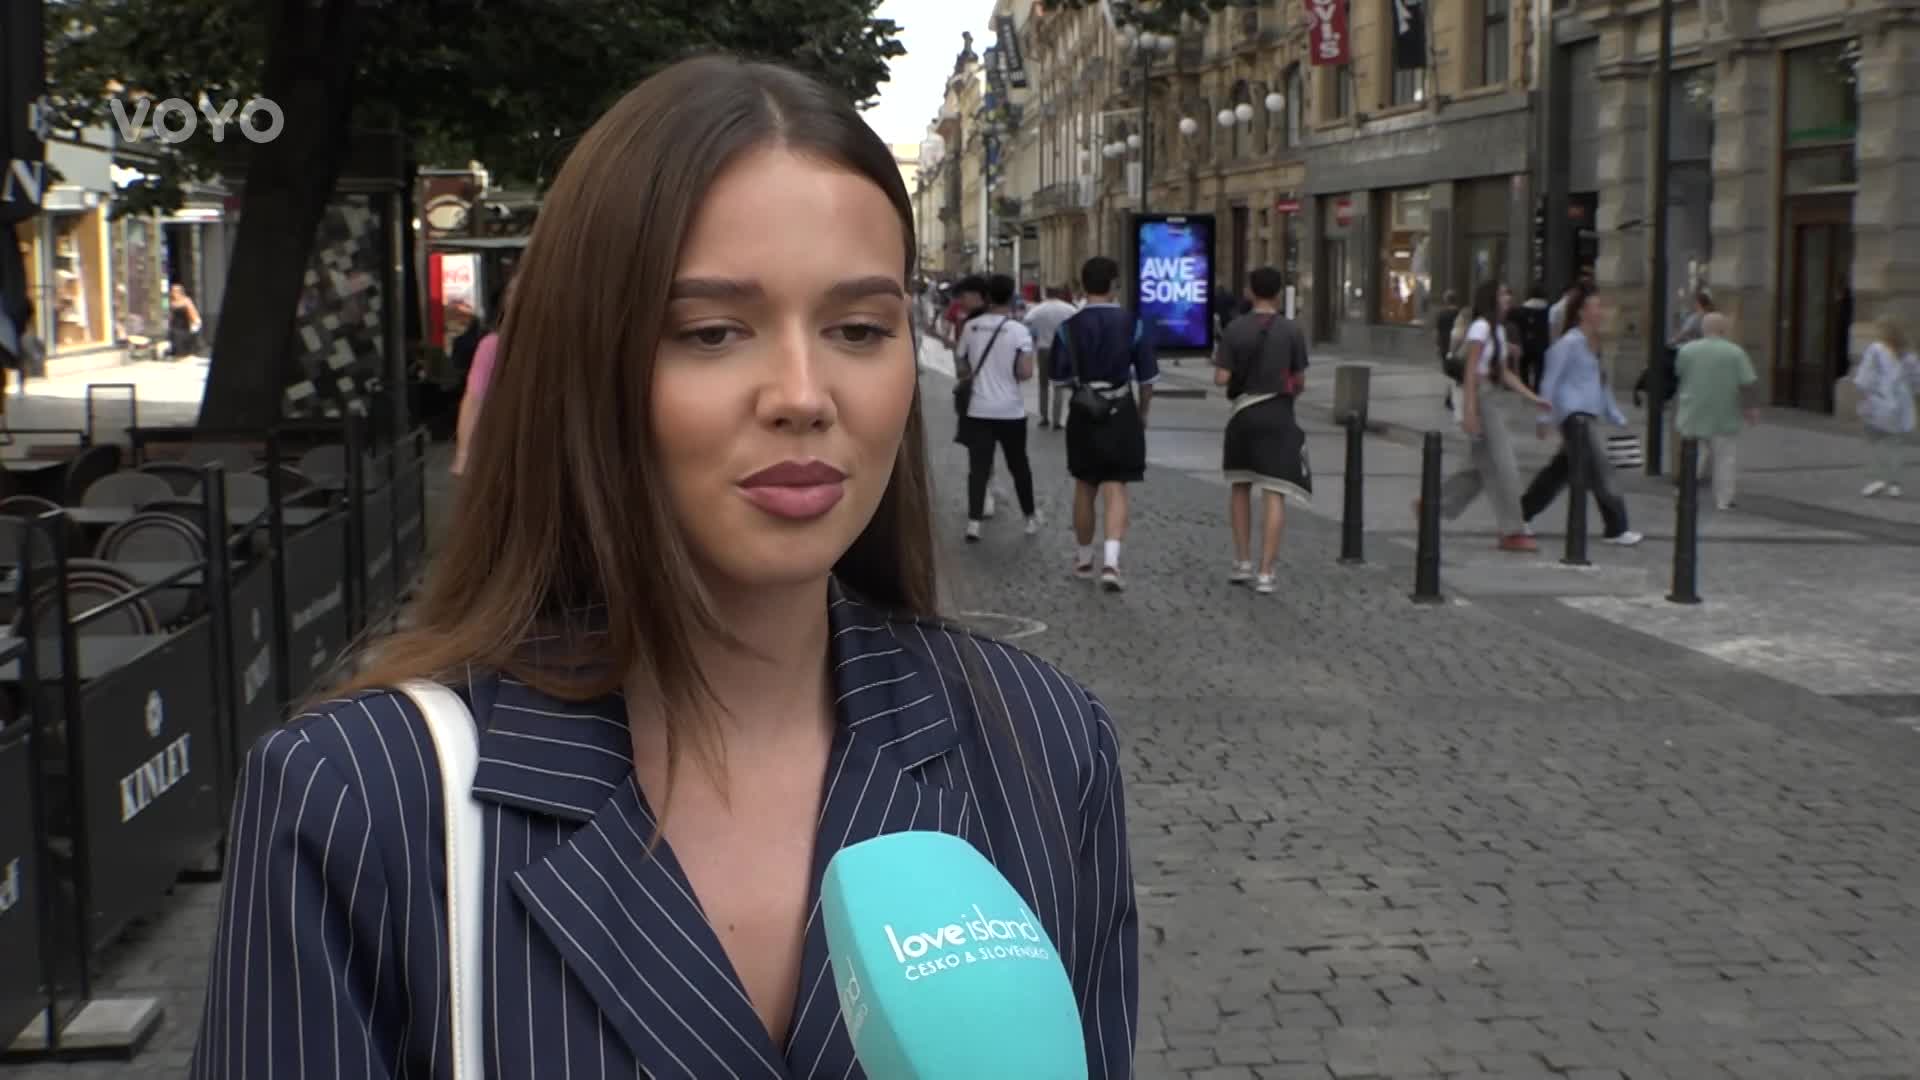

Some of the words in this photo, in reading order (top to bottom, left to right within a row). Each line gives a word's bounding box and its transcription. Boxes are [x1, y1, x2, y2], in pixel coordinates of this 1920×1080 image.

[1141, 256, 1196, 280] AWE
[1141, 280, 1208, 304] SOME
[120, 732, 190, 823] KINLEY
[884, 924, 967, 963] love
[961, 903, 1041, 942] island
